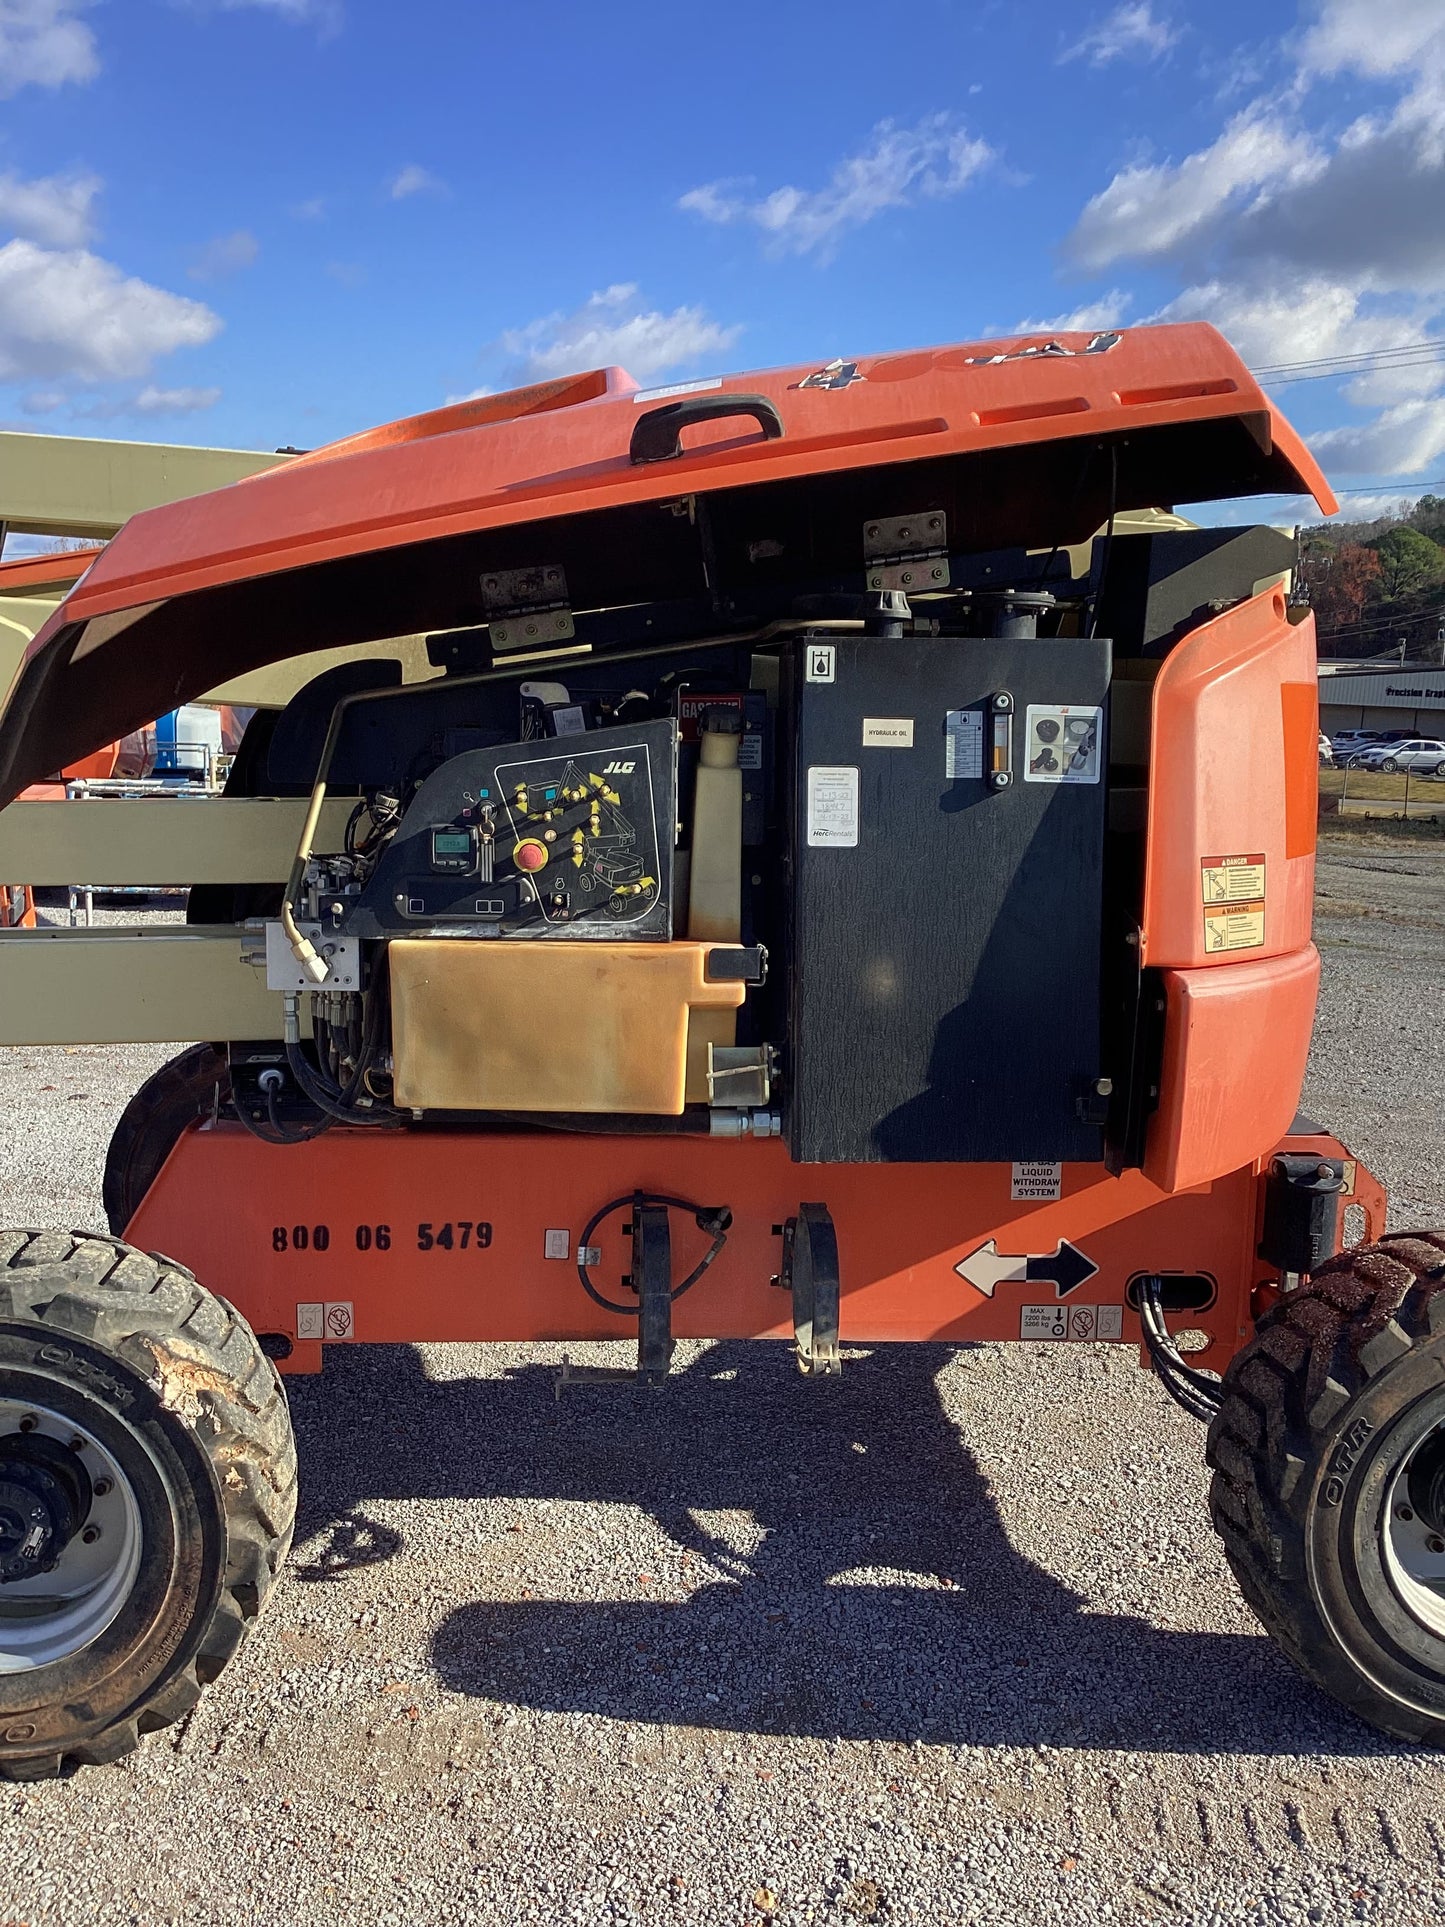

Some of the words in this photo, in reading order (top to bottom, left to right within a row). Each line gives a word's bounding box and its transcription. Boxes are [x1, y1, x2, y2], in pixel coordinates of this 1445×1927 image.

[1386, 687, 1423, 697] Precision
[603, 761, 636, 773] JLG
[1226, 857, 1248, 865] DANGER
[1226, 905, 1250, 915] WARNING
[272, 1225, 330, 1252] 800
[355, 1224, 391, 1251] 06
[417, 1222, 493, 1251] 5479
[1041, 1321, 1050, 1329] kg
[1317, 1416, 1375, 1508] OTR
